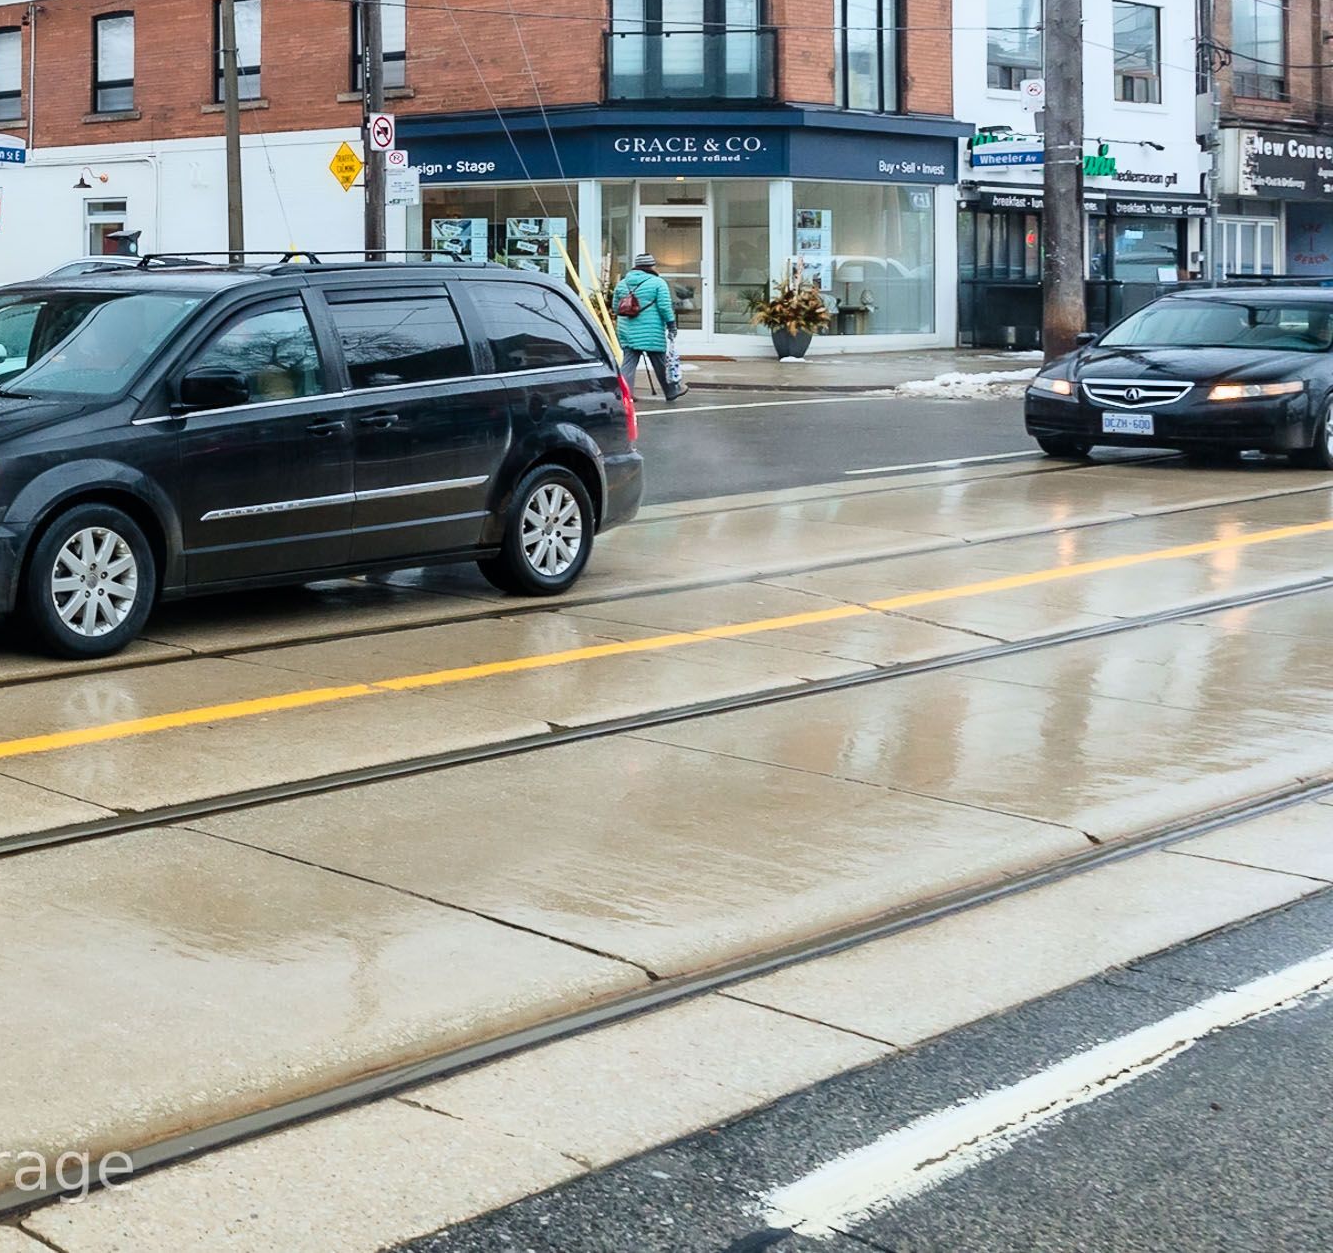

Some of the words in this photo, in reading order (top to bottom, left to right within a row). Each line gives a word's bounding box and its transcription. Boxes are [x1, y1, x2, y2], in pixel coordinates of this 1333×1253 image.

[614, 137, 697, 153] GRACE
[703, 137, 720, 152] &
[725, 136, 768, 152] CO.
[1254, 136, 1285, 157] New
[1287, 139, 1333, 163] Conce
[15, 150, 21, 161] E
[702, 154, 741, 162] refined
[979, 153, 1023, 165] Wheeler
[456, 160, 496, 174] Stage
[878, 160, 895, 175] Buy
[901, 161, 916, 174] Sell
[922, 163, 945, 176] Invest
